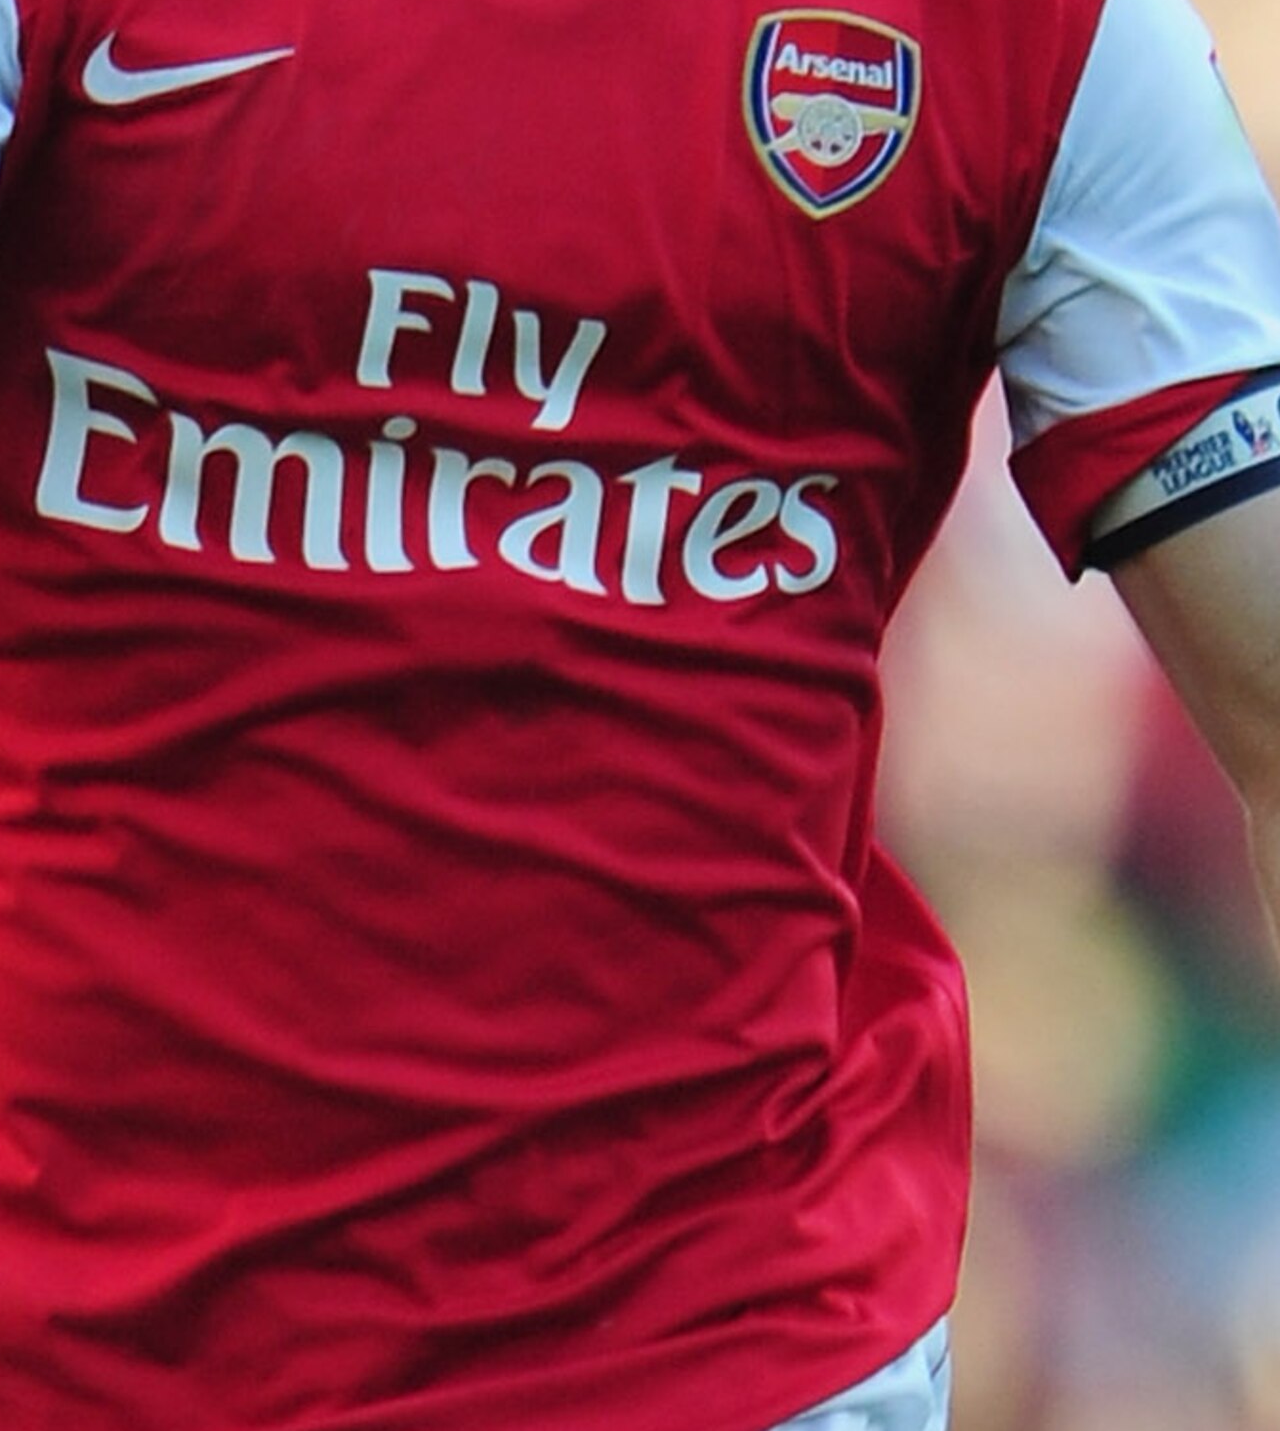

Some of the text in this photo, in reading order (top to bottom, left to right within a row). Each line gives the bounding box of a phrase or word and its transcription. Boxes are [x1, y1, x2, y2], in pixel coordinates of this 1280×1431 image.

[775, 42, 892, 89] Arsenal
[356, 268, 607, 431] Fly
[35, 347, 840, 605] Emirates
[1152, 431, 1231, 479] PREMIER
[1162, 450, 1237, 496] LEAGUE
